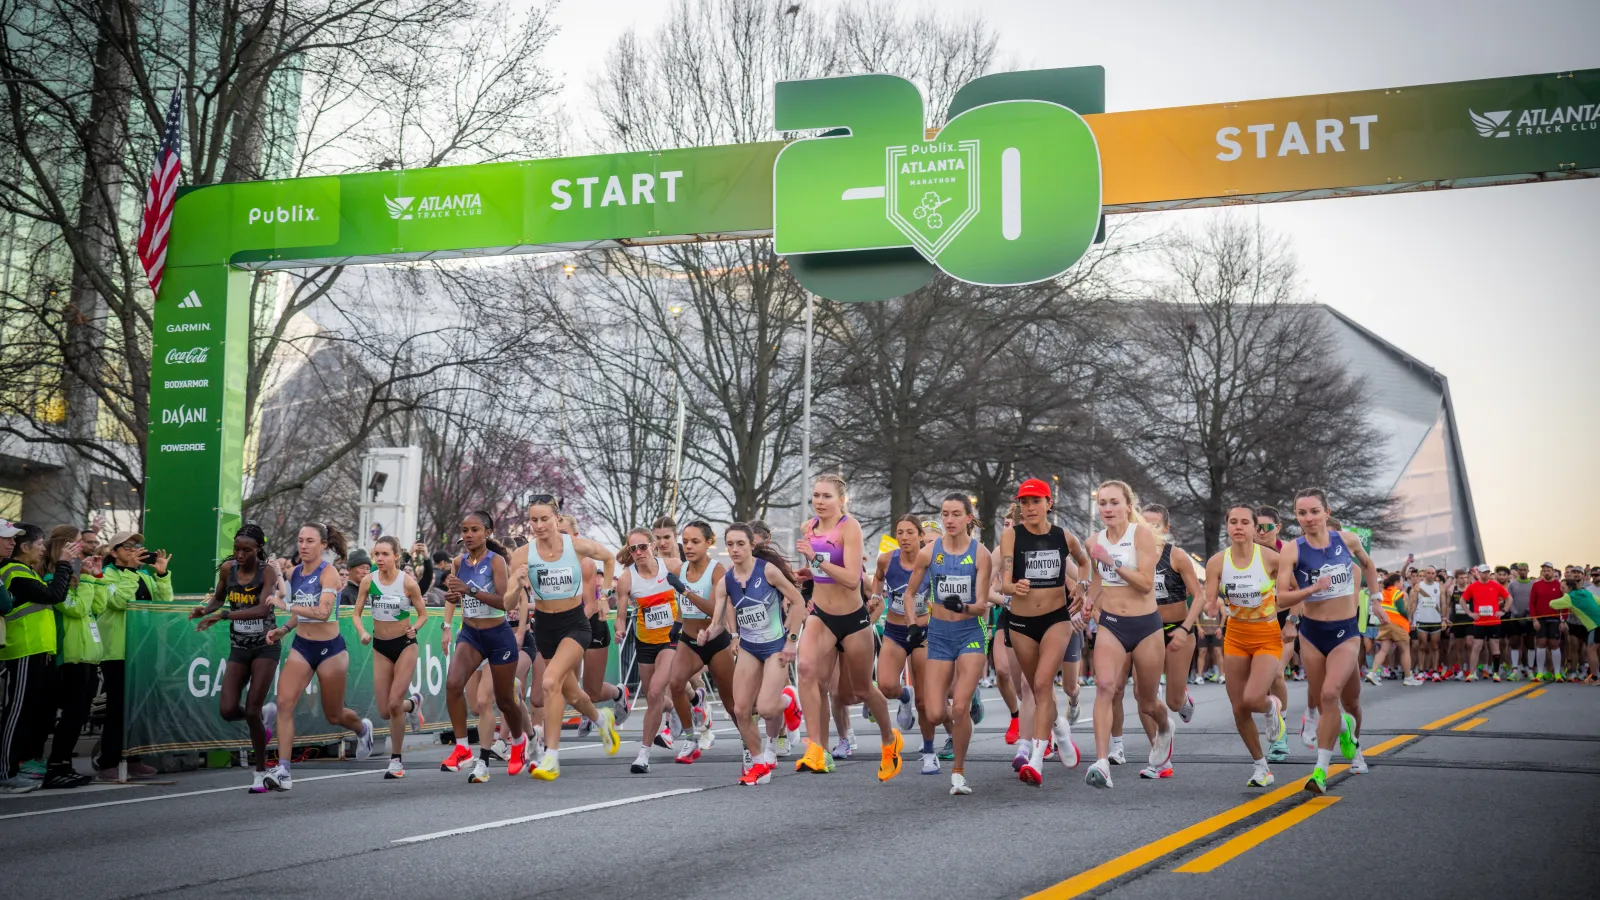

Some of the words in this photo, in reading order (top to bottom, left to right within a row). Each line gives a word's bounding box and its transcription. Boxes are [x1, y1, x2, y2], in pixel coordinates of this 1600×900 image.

[1516, 125, 1562, 136] TRACK
[1216, 115, 1379, 161] START
[912, 143, 953, 154] Publix
[901, 158, 965, 174] ATLANTA
[910, 177, 956, 186] MARATHON
[551, 171, 683, 211] START
[417, 193, 482, 211] ATLANTA
[248, 205, 316, 225] Publix
[417, 210, 450, 219] TRACK
[456, 208, 482, 217] CLUB
[166, 323, 210, 333] GARMIN
[165, 346, 210, 365] Coca-Cola
[165, 379, 209, 389] BODYARMOR
[161, 405, 207, 428] DASANI
[160, 442, 206, 452] POWERADE
[1026, 559, 1060, 570] MONTOYA
[541, 575, 573, 587] MCCLAIN
[939, 583, 968, 594] SAILOR
[228, 591, 256, 605] ARMY
[647, 610, 669, 623] SMITH
[737, 611, 766, 625] HURLEY
